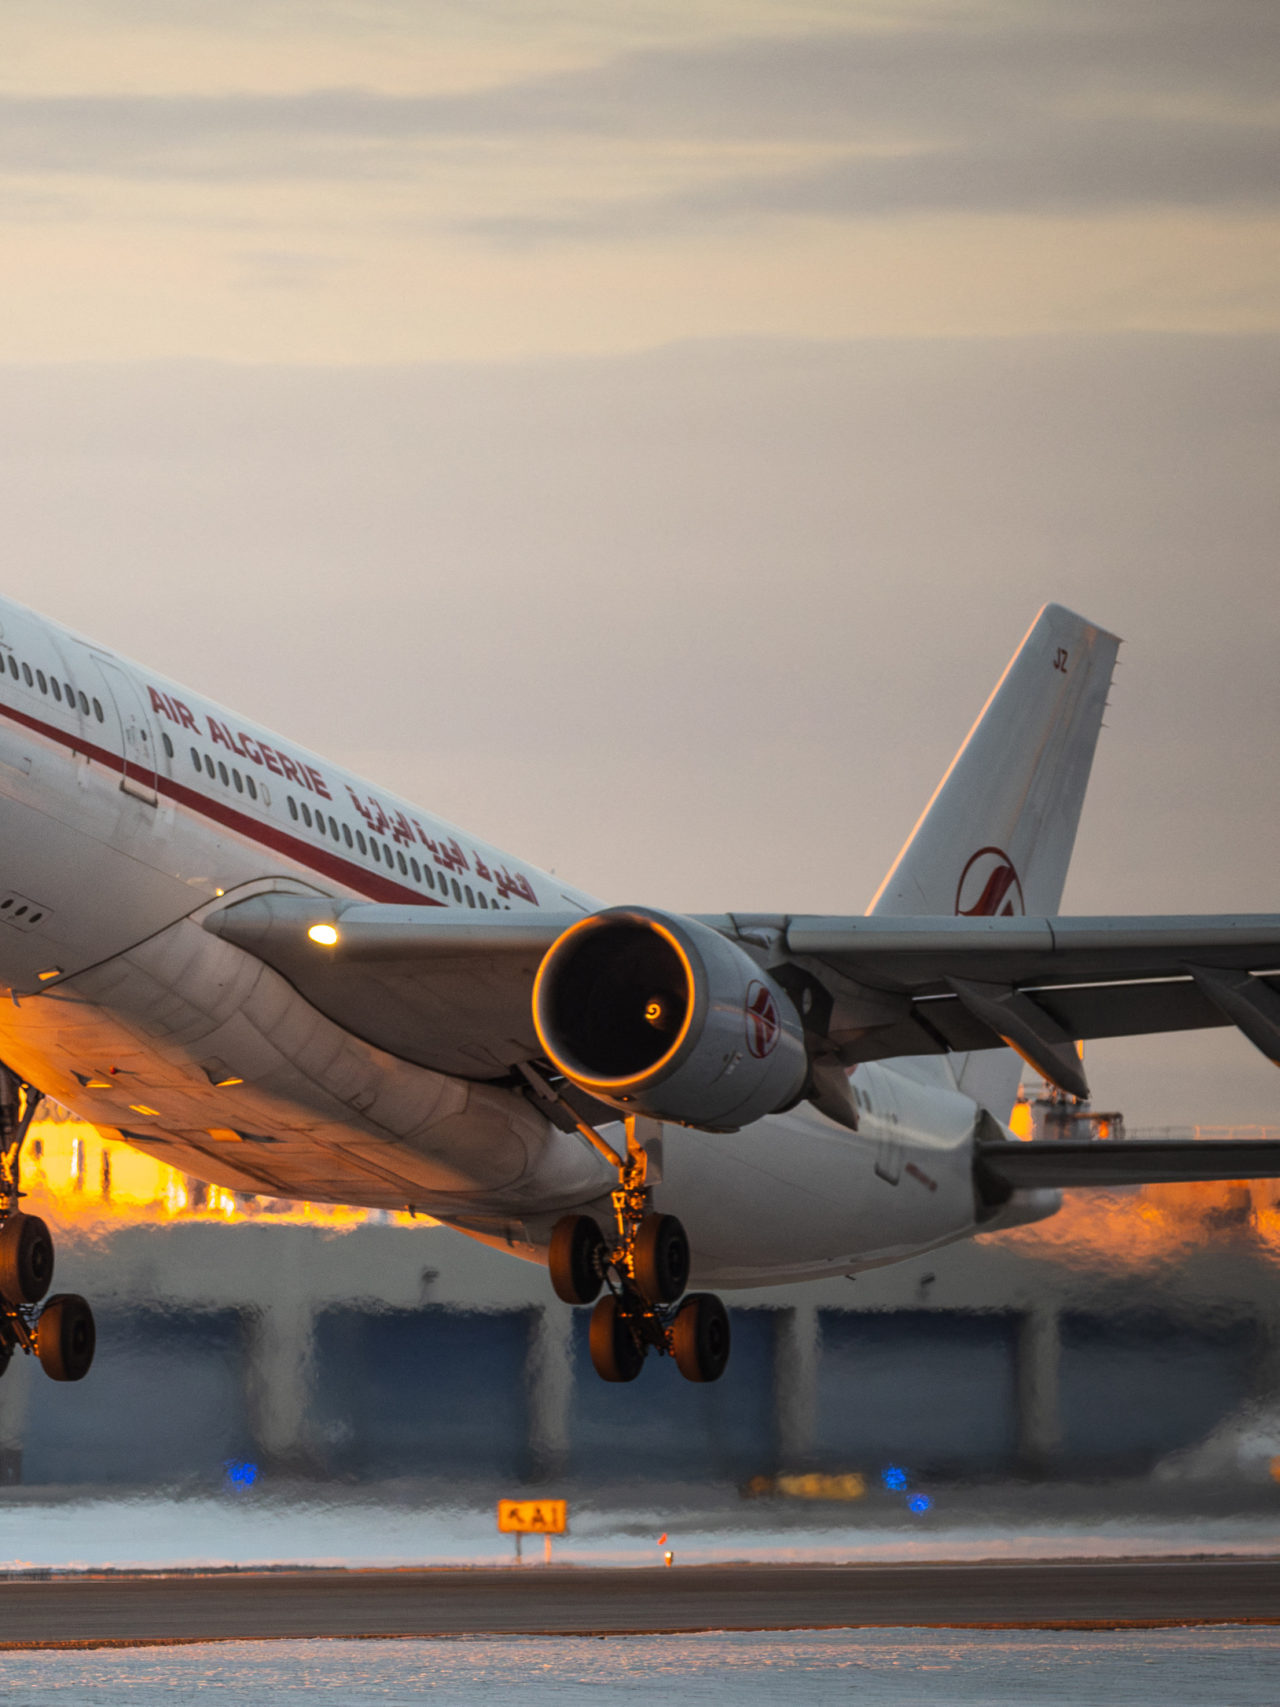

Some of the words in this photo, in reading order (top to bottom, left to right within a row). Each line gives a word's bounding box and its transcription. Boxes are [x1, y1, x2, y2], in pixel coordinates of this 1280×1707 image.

[1053, 647, 1068, 673] JZ
[146, 685, 202, 736] AIR
[206, 715, 333, 801] ALGERIE
[411, 818, 470, 876] الجوية
[472, 850, 540, 907] الخطوط
